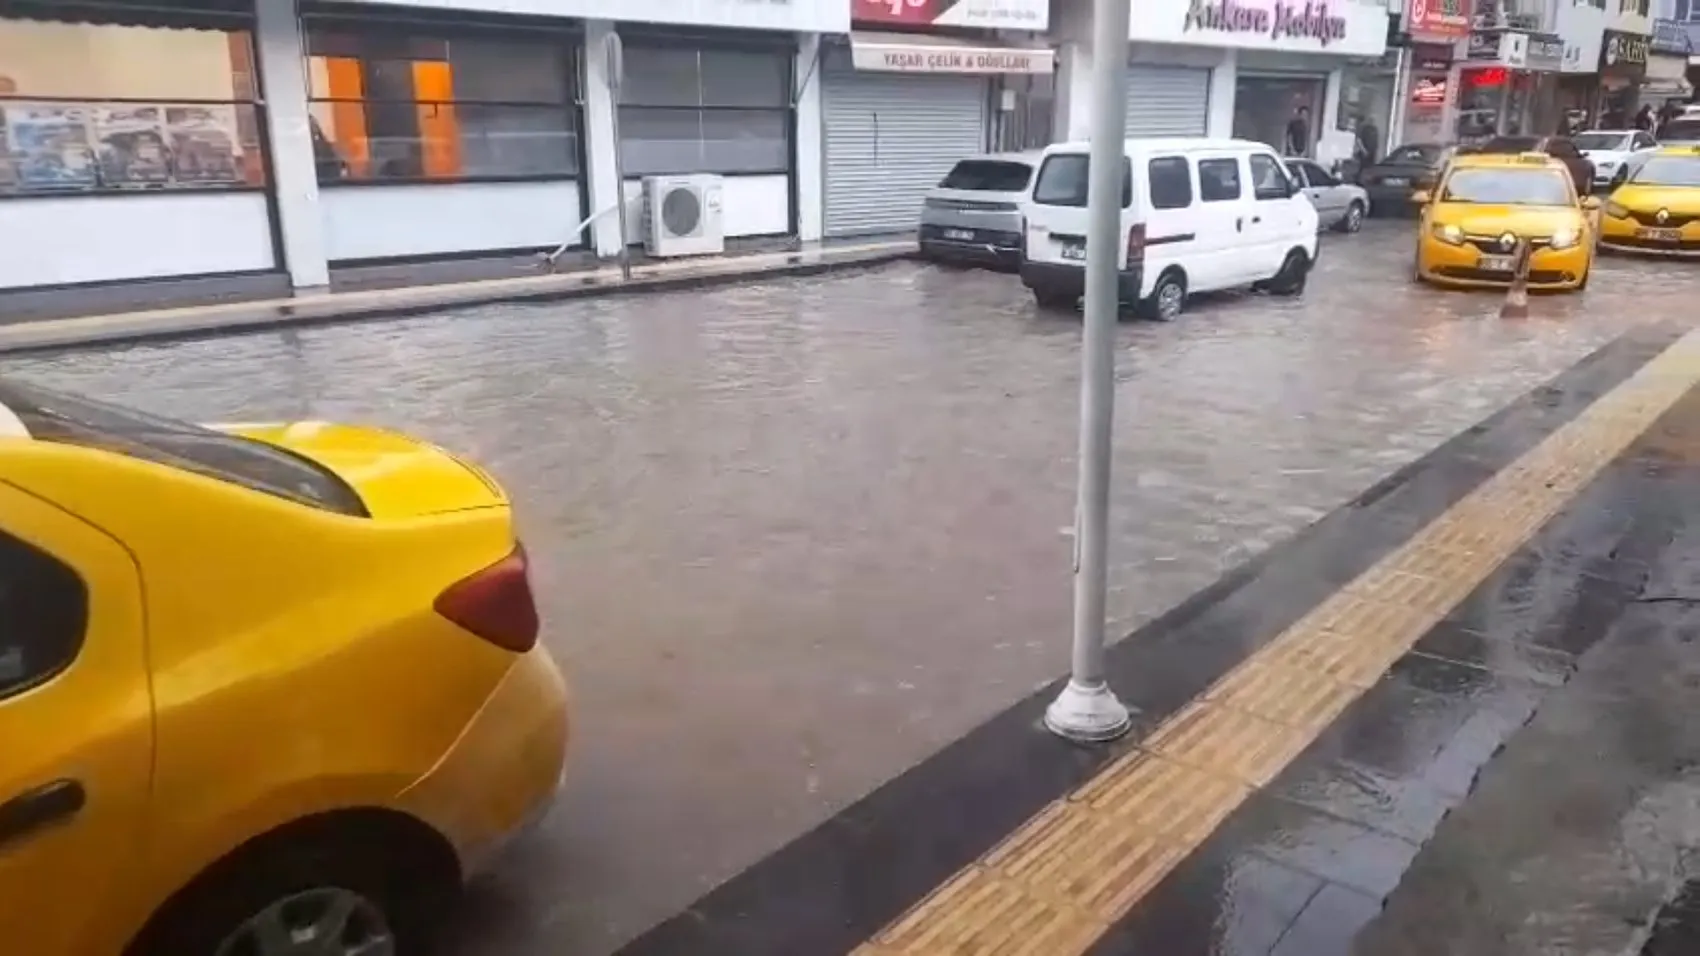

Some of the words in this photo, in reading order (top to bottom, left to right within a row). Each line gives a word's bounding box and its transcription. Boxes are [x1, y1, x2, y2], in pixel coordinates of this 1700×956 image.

[1183, 0, 1269, 32] Ankara
[1271, 0, 1346, 47] Mobilya
[884, 53, 923, 69] YAŞAR
